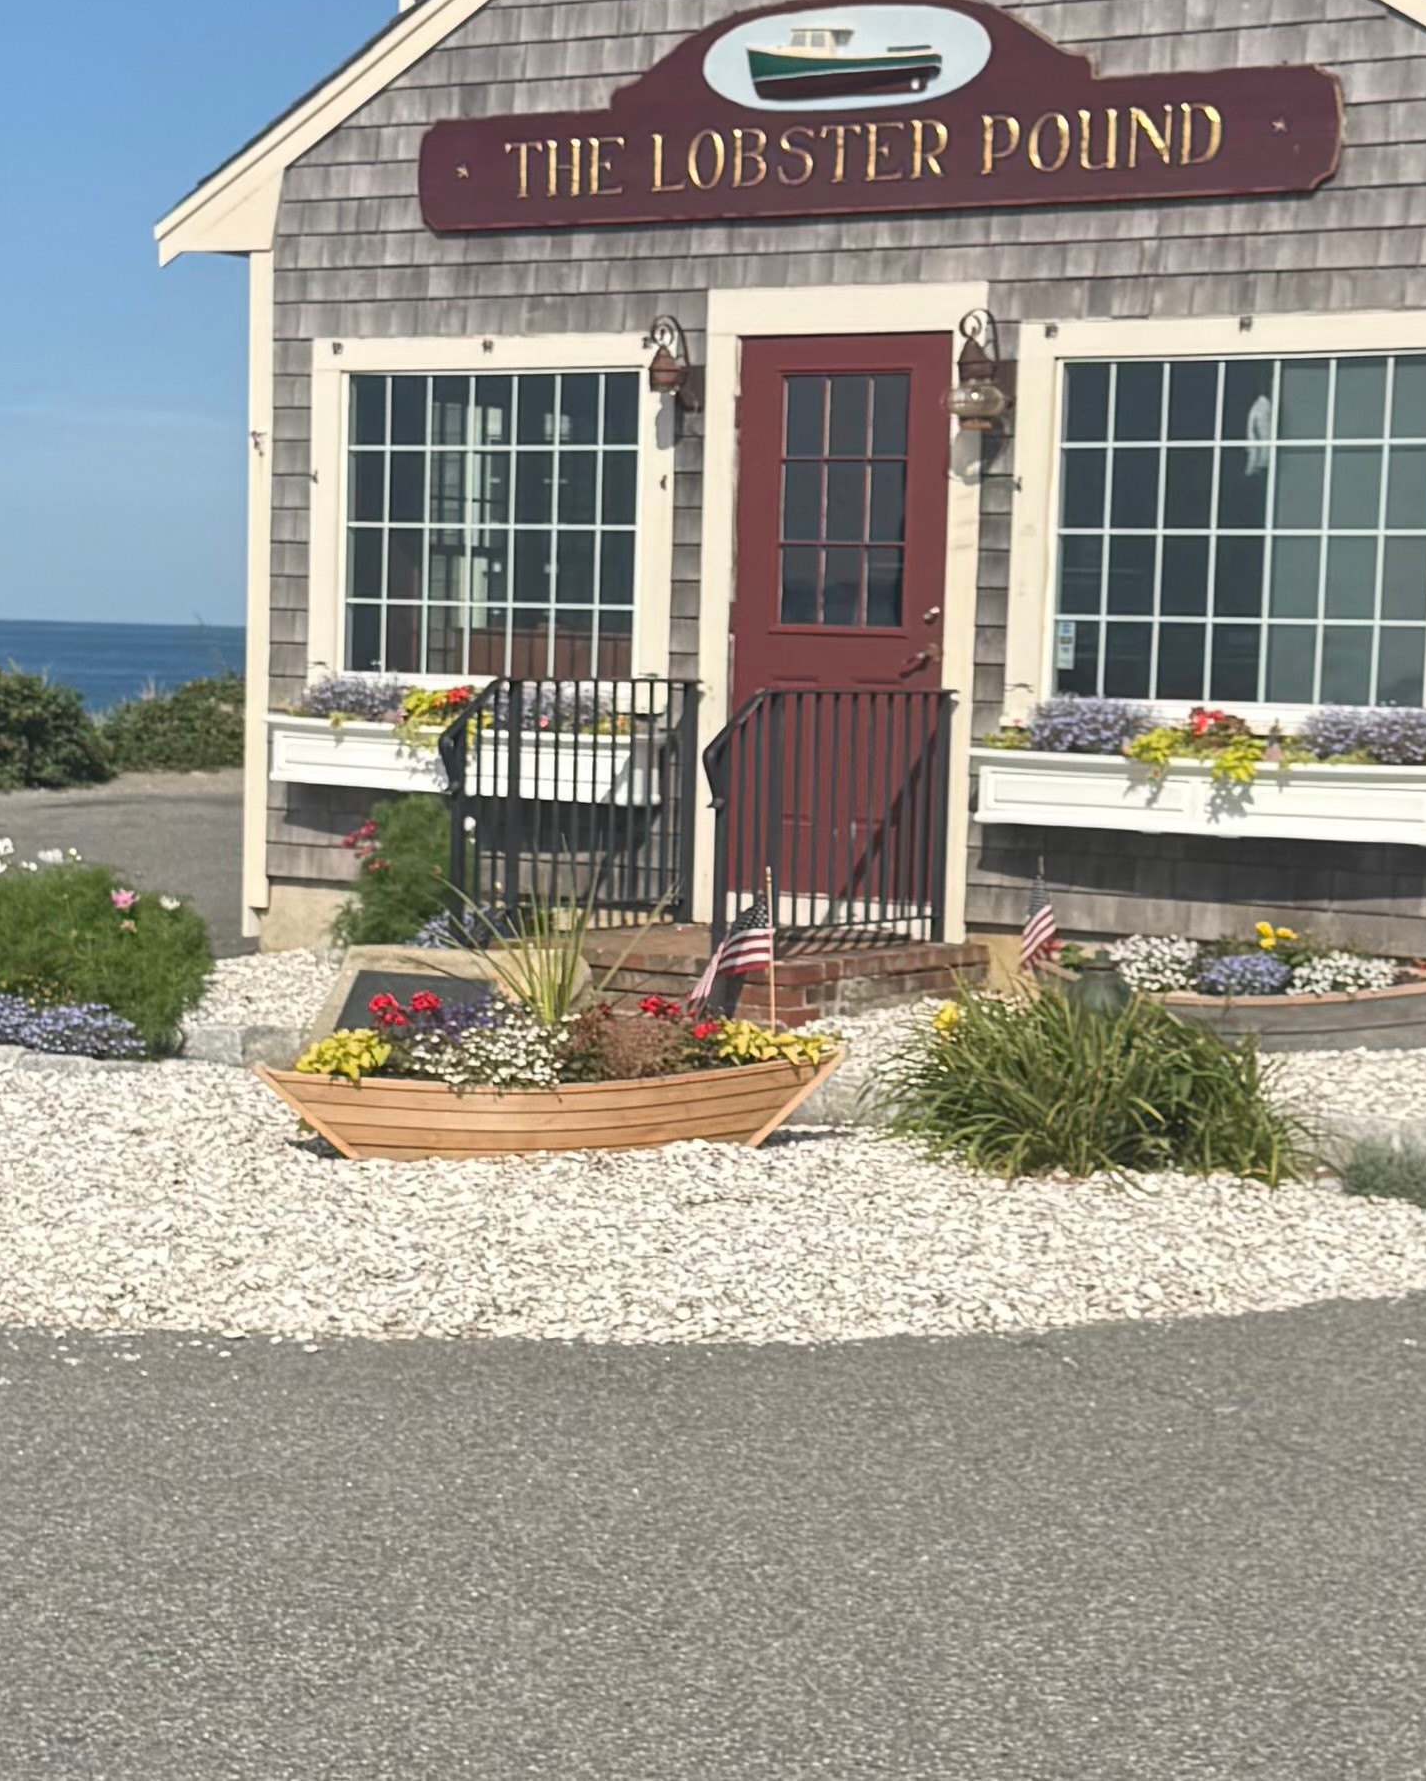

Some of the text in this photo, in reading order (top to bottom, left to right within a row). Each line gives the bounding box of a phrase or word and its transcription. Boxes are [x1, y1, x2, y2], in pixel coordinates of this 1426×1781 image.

[504, 102, 1222, 199] THE LOBSTER POUND
